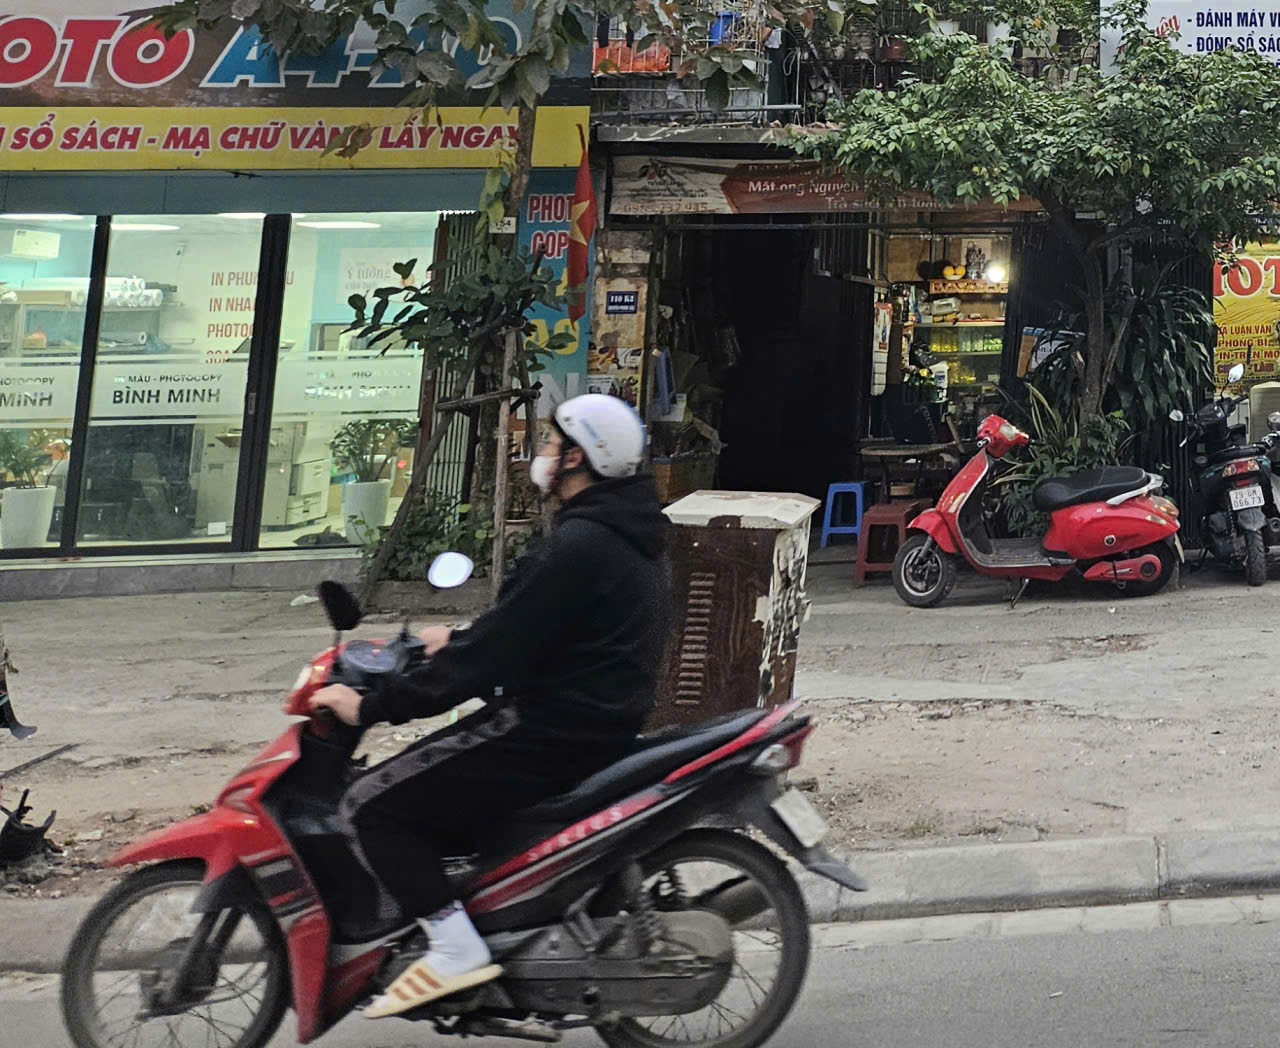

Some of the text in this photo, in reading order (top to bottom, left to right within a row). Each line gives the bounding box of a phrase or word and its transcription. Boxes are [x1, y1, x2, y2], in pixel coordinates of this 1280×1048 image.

[1196, 9, 1232, 27] ĐÁNH
[1237, 9, 1265, 27] MÁY
[1270, 12, 1280, 27] VI
[10, 113, 55, 150] SỔ
[59, 120, 142, 150] SÁCH
[162, 127, 210, 157] MẠ
[220, 122, 287, 150] CHỮ
[379, 110, 437, 149] LẤY
[211, 271, 224, 286] IN
[209, 297, 222, 312] IN
[113, 386, 221, 404] BÌNH MINH
